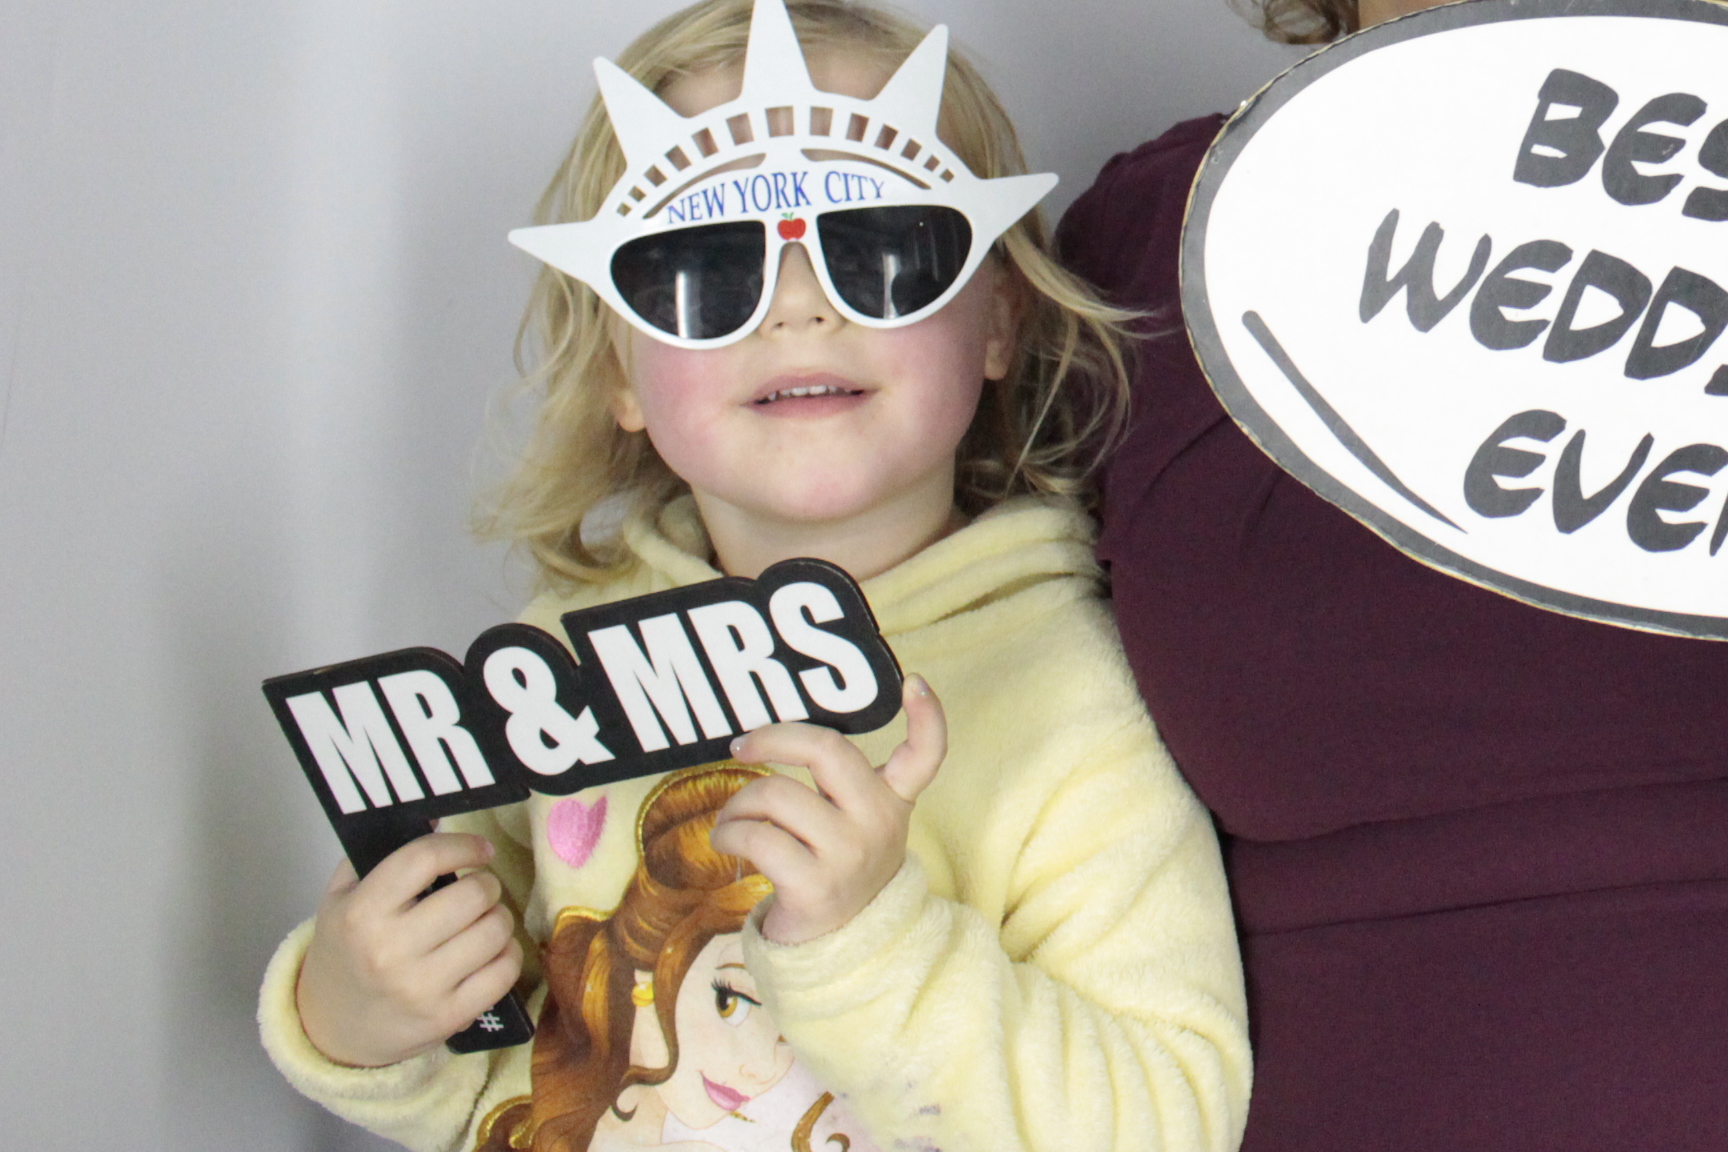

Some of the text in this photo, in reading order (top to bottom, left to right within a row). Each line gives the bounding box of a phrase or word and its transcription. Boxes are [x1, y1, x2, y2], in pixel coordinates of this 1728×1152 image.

[667, 170, 885, 224] NEW YORK CITY
[285, 582, 879, 815] MR & MRS
